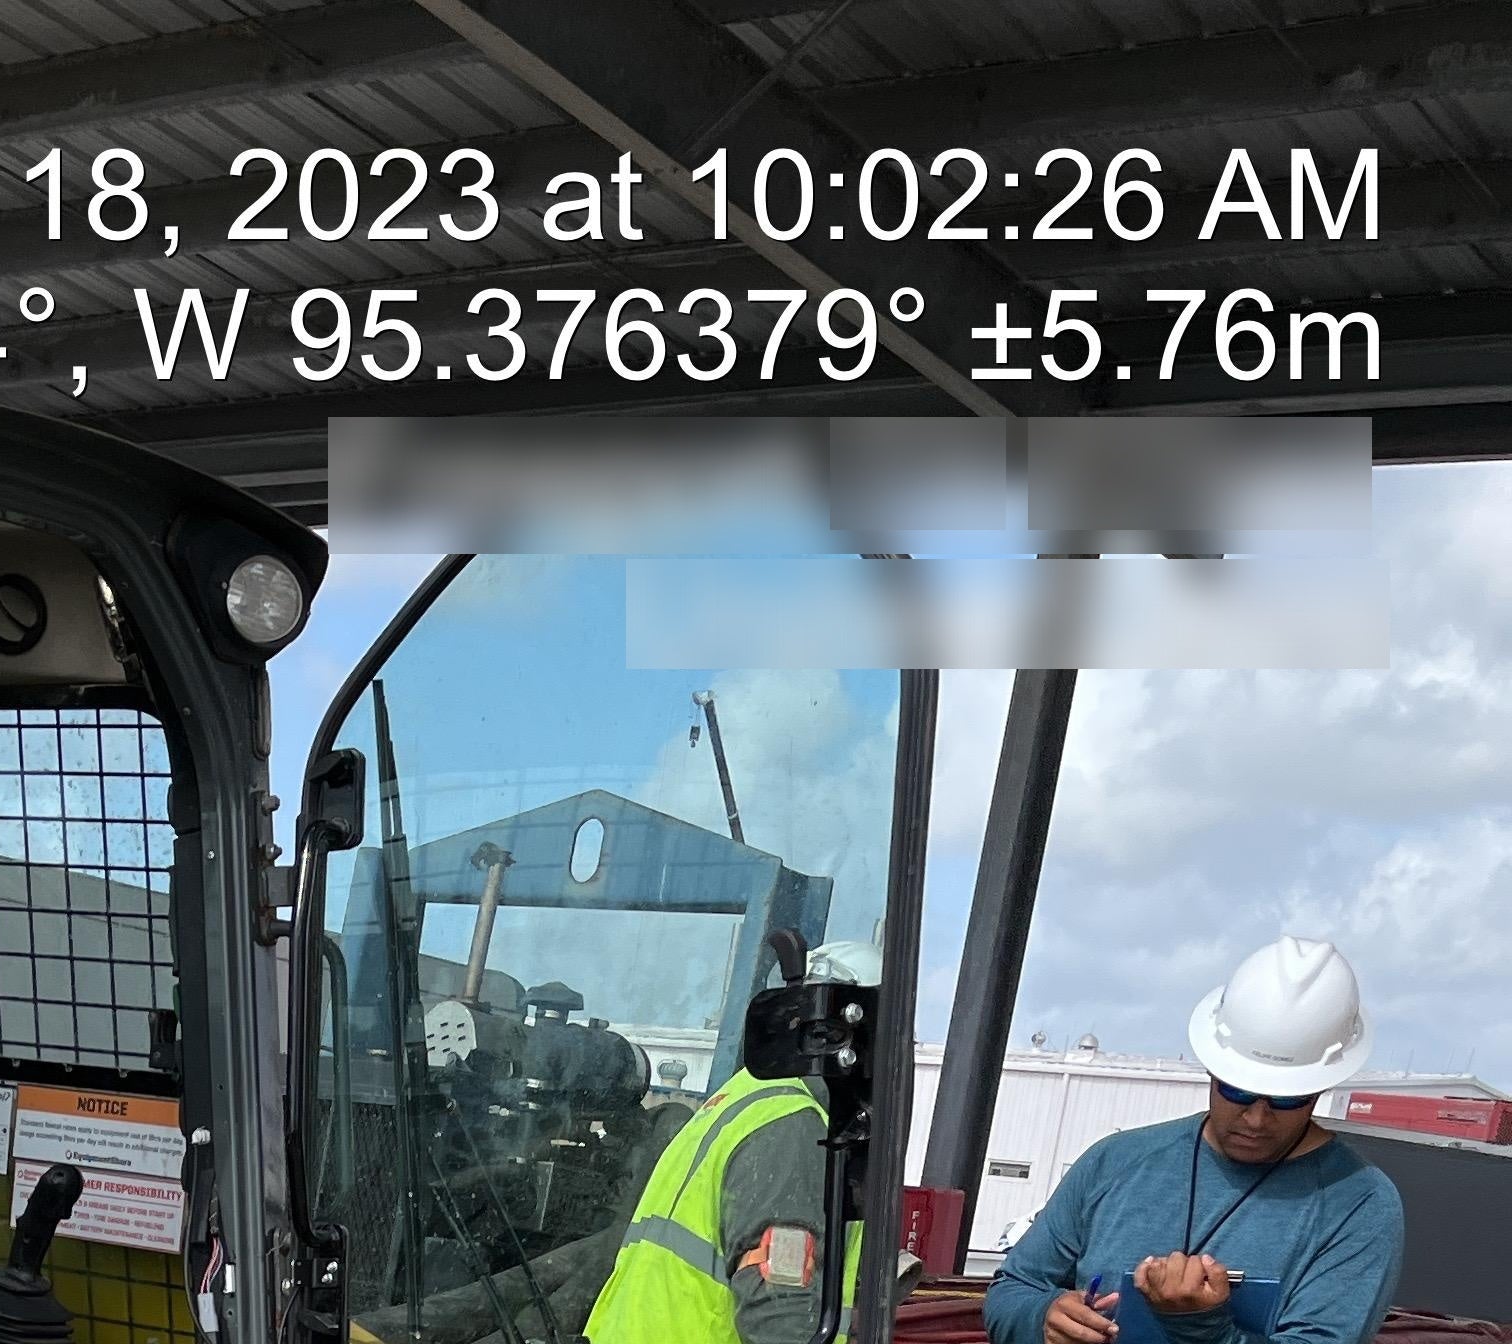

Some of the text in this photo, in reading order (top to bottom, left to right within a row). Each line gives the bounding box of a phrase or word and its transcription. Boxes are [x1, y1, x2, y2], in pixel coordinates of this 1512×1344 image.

[77, 1098, 128, 1116] NOTICE
[104, 1181, 182, 1201] RESPONSIBILITY
[907, 1210, 921, 1252] FIRE
